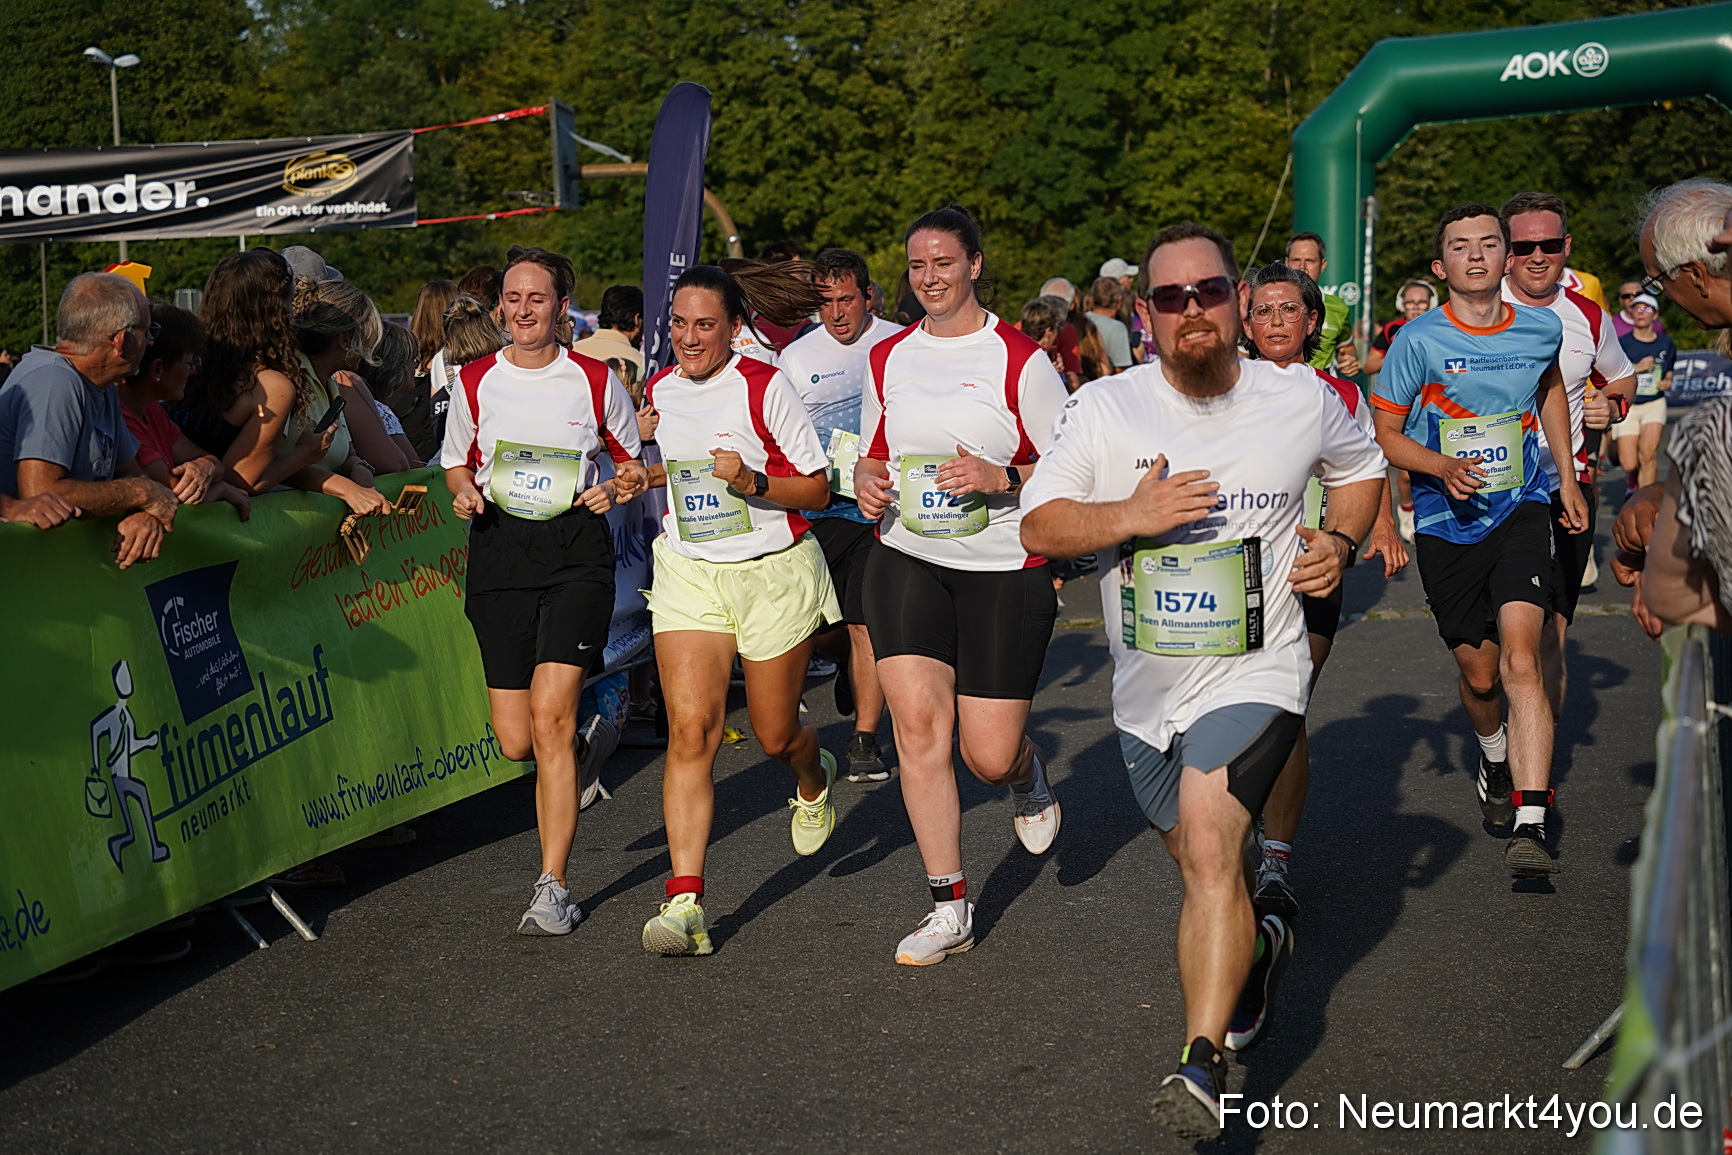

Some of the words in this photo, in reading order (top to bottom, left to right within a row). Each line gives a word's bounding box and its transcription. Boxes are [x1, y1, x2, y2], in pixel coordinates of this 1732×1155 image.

[1499, 49, 1572, 82] AOK
[255, 205, 275, 217] Ein
[277, 205, 300, 217] Ort,
[302, 203, 324, 215] der
[326, 201, 391, 214] verbindet.
[1470, 355, 1520, 365] Raiffeisenbank
[1470, 363, 1504, 372] Neumarkt
[1671, 372, 1732, 392] Fisch
[1487, 465, 1512, 474] ofbauer
[513, 471, 552, 492] 590
[508, 490, 531, 500] Katrin
[685, 493, 720, 512] 674
[921, 491, 960, 508] 672
[1216, 487, 1289, 511] erhorn
[697, 509, 742, 522] Weixelbaum
[931, 512, 969, 521] Weidinger
[334, 570, 408, 630] laufen
[1154, 590, 1217, 613] 1574
[172, 610, 218, 647] Fischer
[1139, 614, 1159, 627] Sven
[1161, 618, 1240, 629] Allmannsberger
[184, 633, 222, 660] AUTOMOBILE
[159, 643, 334, 807] firmenlauf
[301, 722, 502, 829] www.firmenlauf-oberpf
[180, 775, 252, 844] neumarkt
